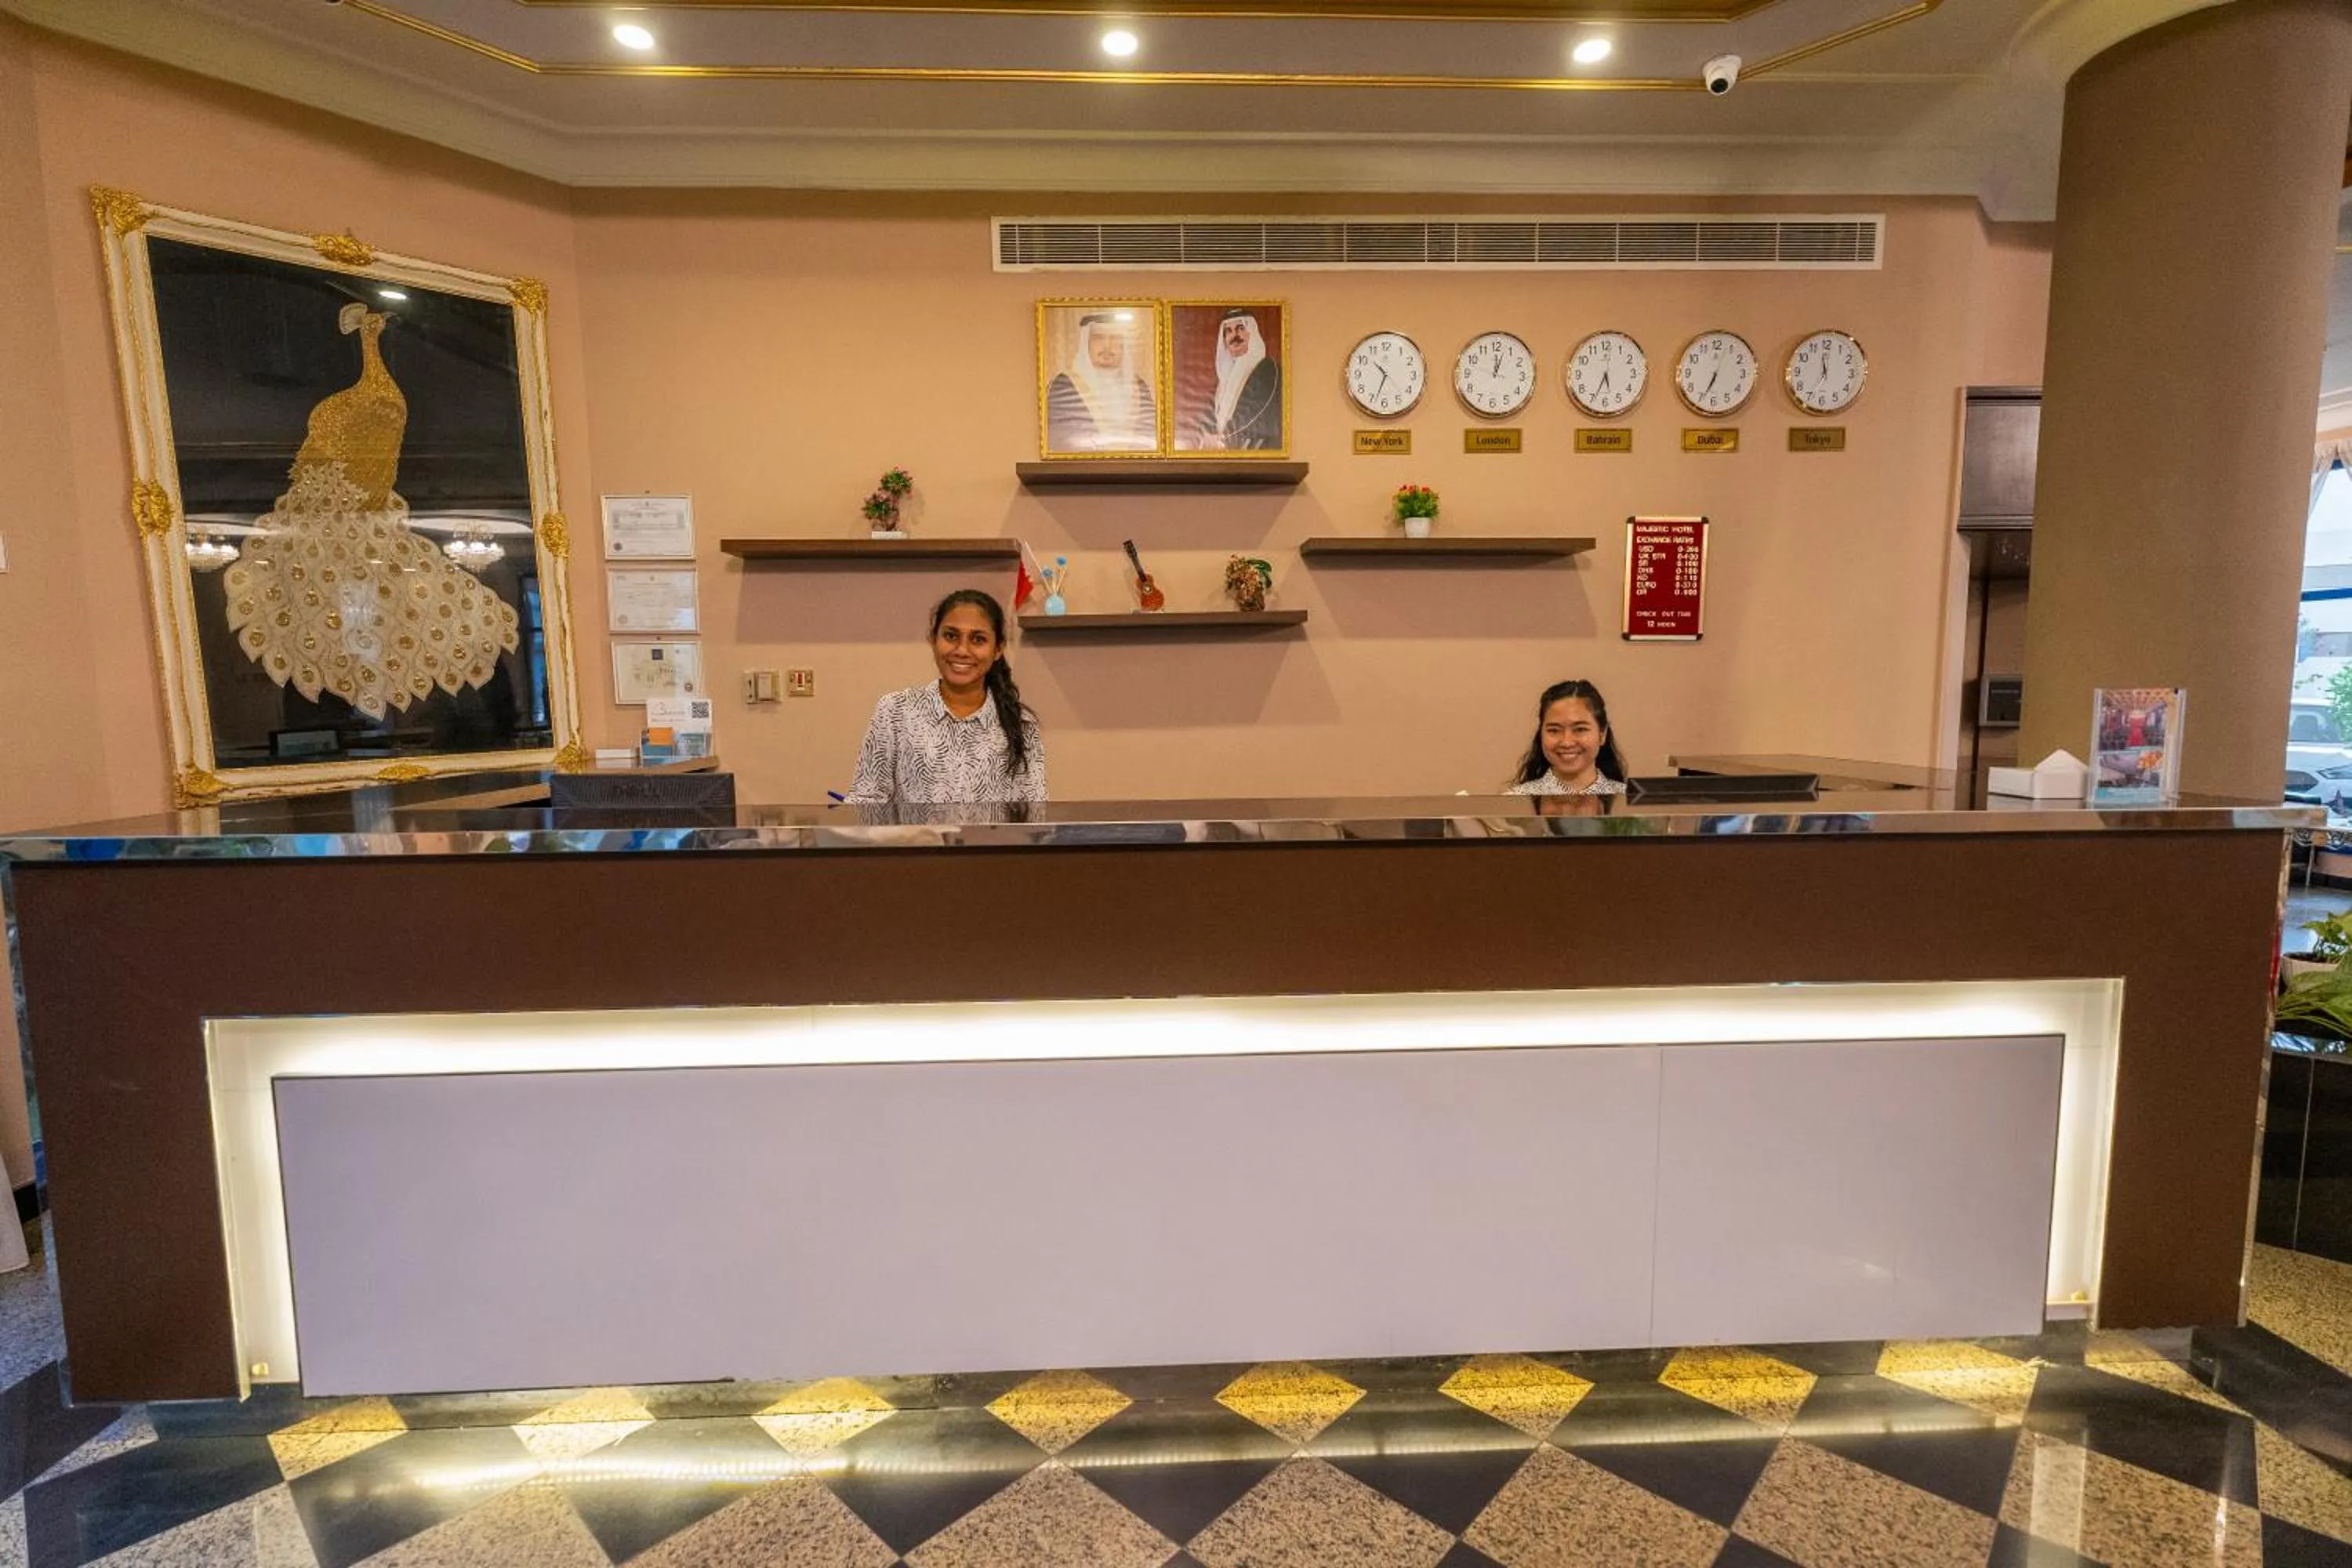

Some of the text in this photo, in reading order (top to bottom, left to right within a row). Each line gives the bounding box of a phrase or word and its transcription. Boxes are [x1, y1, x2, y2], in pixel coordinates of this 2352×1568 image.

[1369, 346, 1377, 354] 11
[1381, 342, 1391, 351] 12
[1479, 345, 1486, 355] 11
[1492, 341, 1501, 352] 12
[1588, 345, 1596, 355] 11
[1601, 340, 1611, 350] 12
[1700, 344, 1708, 354] 11
[1712, 340, 1722, 350] 12
[1809, 343, 1817, 354] 11
[1822, 340, 1831, 350] 12
[1359, 355, 1367, 365] 10
[1406, 356, 1413, 366] 2
[1468, 354, 1478, 364] 10
[1516, 358, 1523, 367] 2
[1579, 355, 1588, 365] 10
[1627, 354, 1632, 364] 2
[1690, 354, 1698, 364] 10
[1737, 354, 1743, 365] 2
[1799, 353, 1808, 362] 10
[1846, 354, 1852, 364] 2
[1355, 368, 1361, 379] 9
[1411, 371, 1417, 381] 3
[1465, 368, 1471, 379] 9
[1576, 370, 1581, 380] 9
[1631, 368, 1636, 378] 3
[1685, 368, 1691, 379] 9
[1740, 368, 1745, 379] 3
[1794, 367, 1800, 376] 9
[1849, 368, 1855, 379] 3
[1519, 372, 1526, 382] 3
[1358, 384, 1364, 394] 8
[1406, 386, 1411, 394] 4
[1467, 383, 1473, 394] 8
[1514, 387, 1519, 395] 4
[1579, 384, 1585, 394] 8
[1626, 383, 1632, 393] 4
[1687, 383, 1693, 393] 8
[1796, 381, 1803, 391] 8
[1842, 383, 1849, 393] 4
[1396, 394, 1401, 405] 5
[1503, 394, 1509, 405] 5
[1602, 397, 1609, 407] 6
[1616, 393, 1621, 403] 5
[1711, 397, 1716, 406] 6
[1724, 393, 1730, 403] 5
[1819, 396, 1825, 407] 6
[1832, 392, 1838, 402] 5
[1381, 398, 1388, 408] 6
[1490, 398, 1496, 408] 6
[1361, 436, 1403, 446] New York
[1476, 435, 1511, 445] London
[1586, 434, 1621, 445] Bahrain
[1697, 434, 1723, 445] Dubai
[1805, 434, 1831, 445] Tokyo
